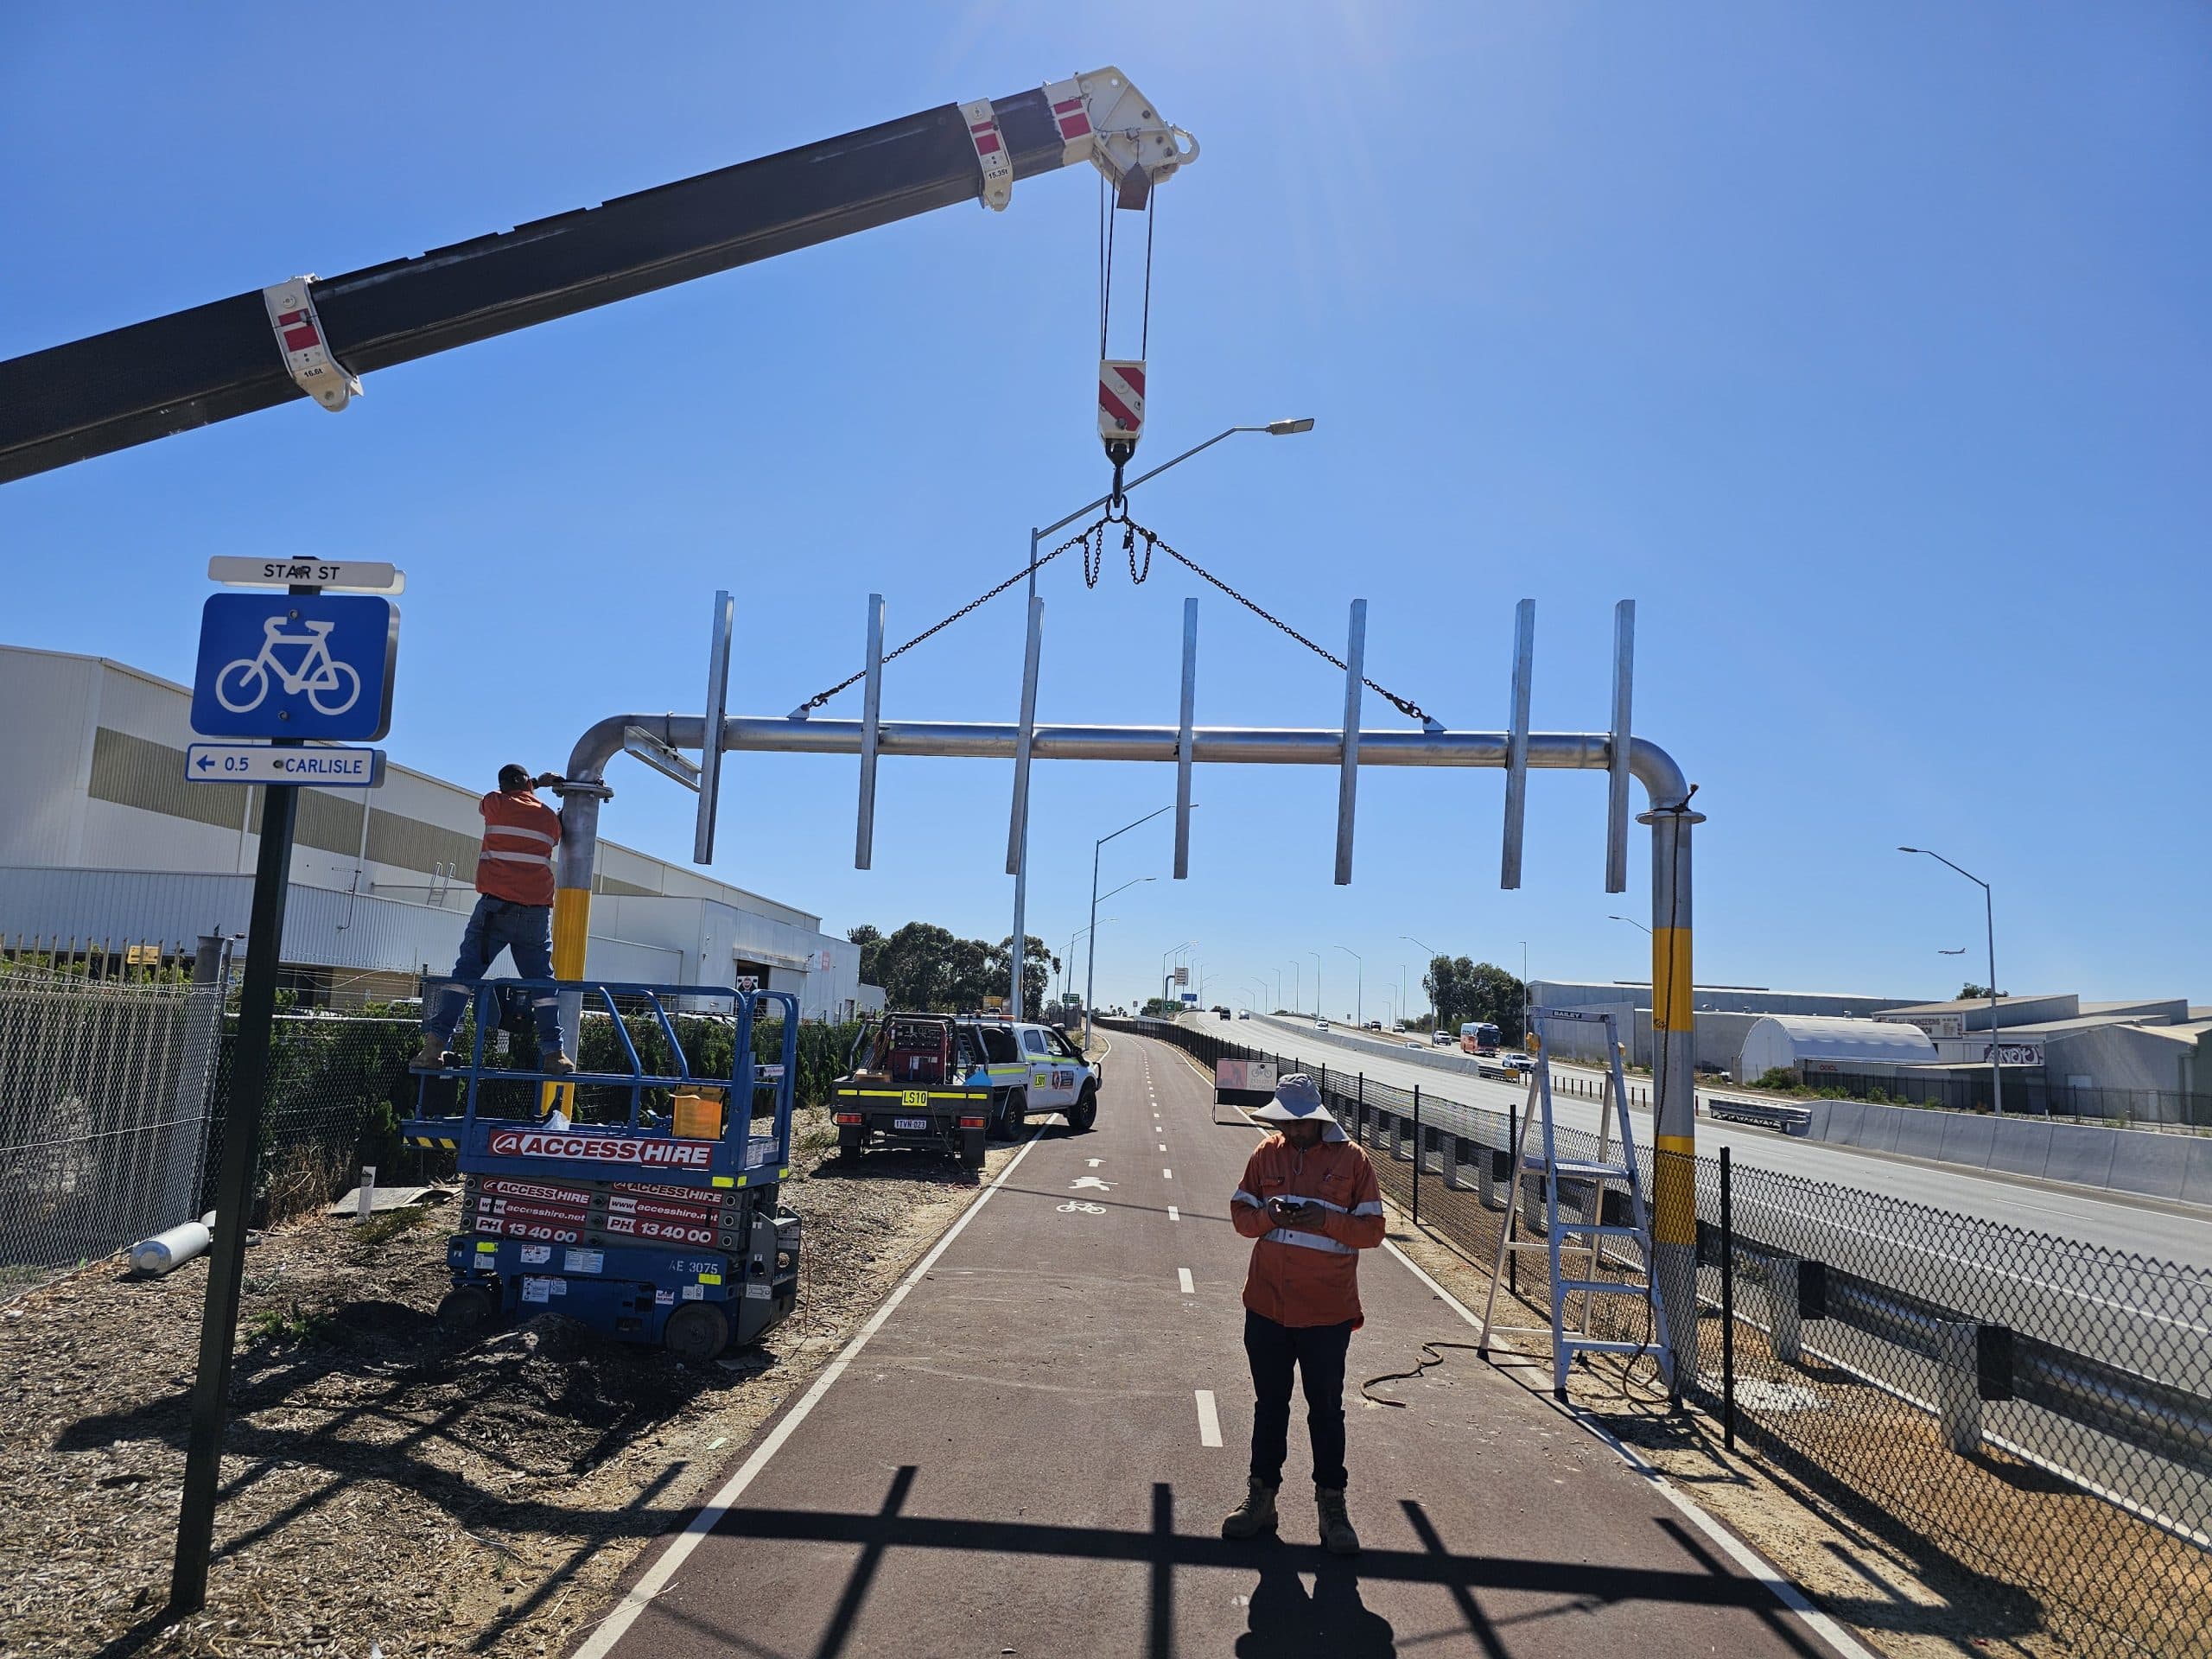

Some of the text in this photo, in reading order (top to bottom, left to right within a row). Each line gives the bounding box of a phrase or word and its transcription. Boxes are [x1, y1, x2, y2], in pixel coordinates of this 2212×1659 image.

[264, 564, 340, 580] STAR ST
[225, 757, 362, 773] 0.5 CARLISLE
[904, 1091, 926, 1103] LS10
[524, 1138, 637, 1160] ACCESS
[643, 1144, 710, 1164] HIRE
[499, 1183, 589, 1204] ACCESS HIRE
[629, 1183, 686, 1198] ACCESS
[481, 1201, 504, 1211] ww
[612, 1200, 634, 1209] www
[480, 1219, 577, 1243] PH 13 40 00
[610, 1218, 711, 1243] PH 13 40 00
[669, 1260, 719, 1274] AE 3075
